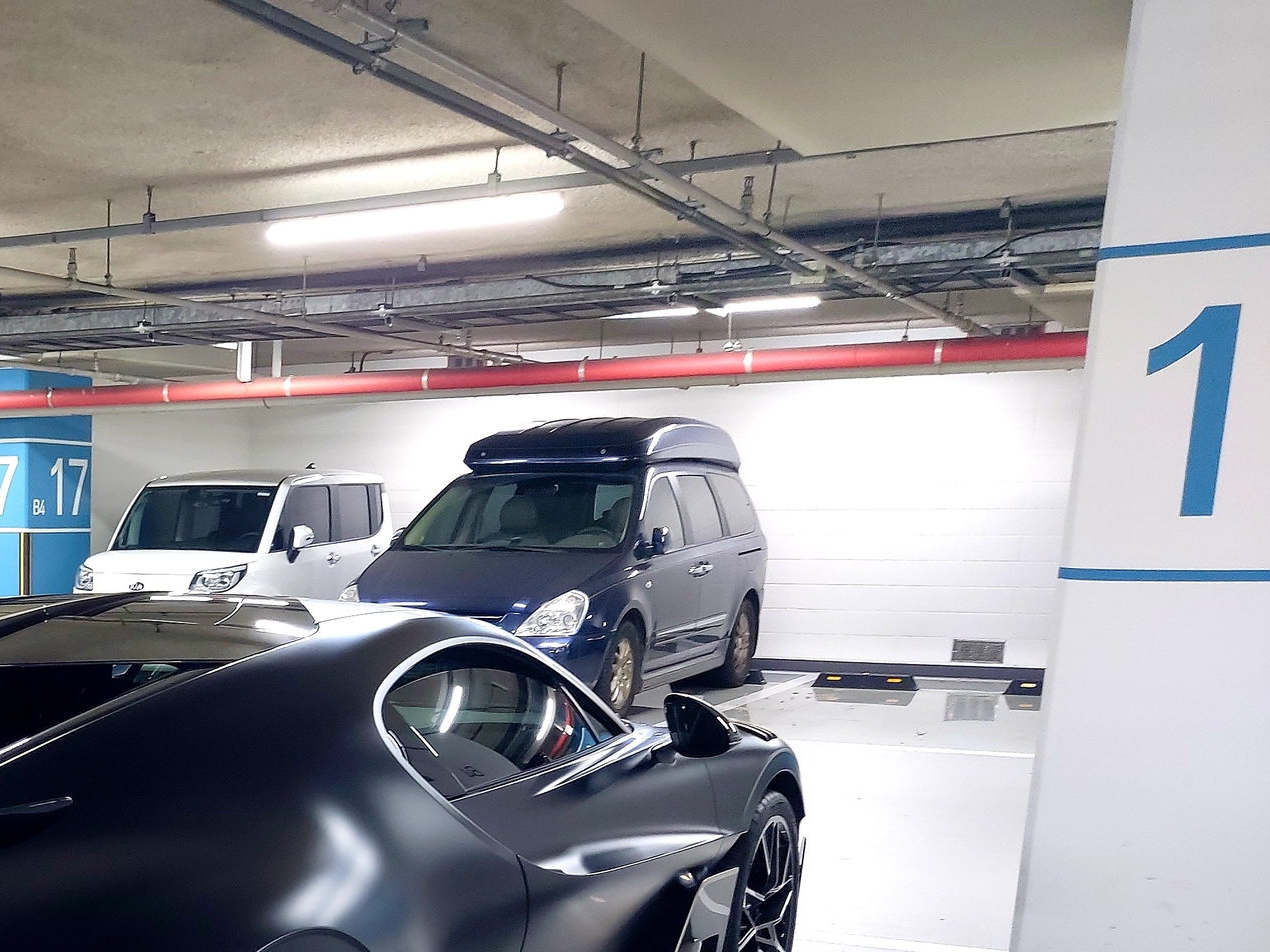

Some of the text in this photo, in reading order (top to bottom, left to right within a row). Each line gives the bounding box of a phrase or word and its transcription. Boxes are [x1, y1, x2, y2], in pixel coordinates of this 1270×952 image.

[1146, 303, 1242, 516] 1
[32, 457, 88, 516] B4 17
